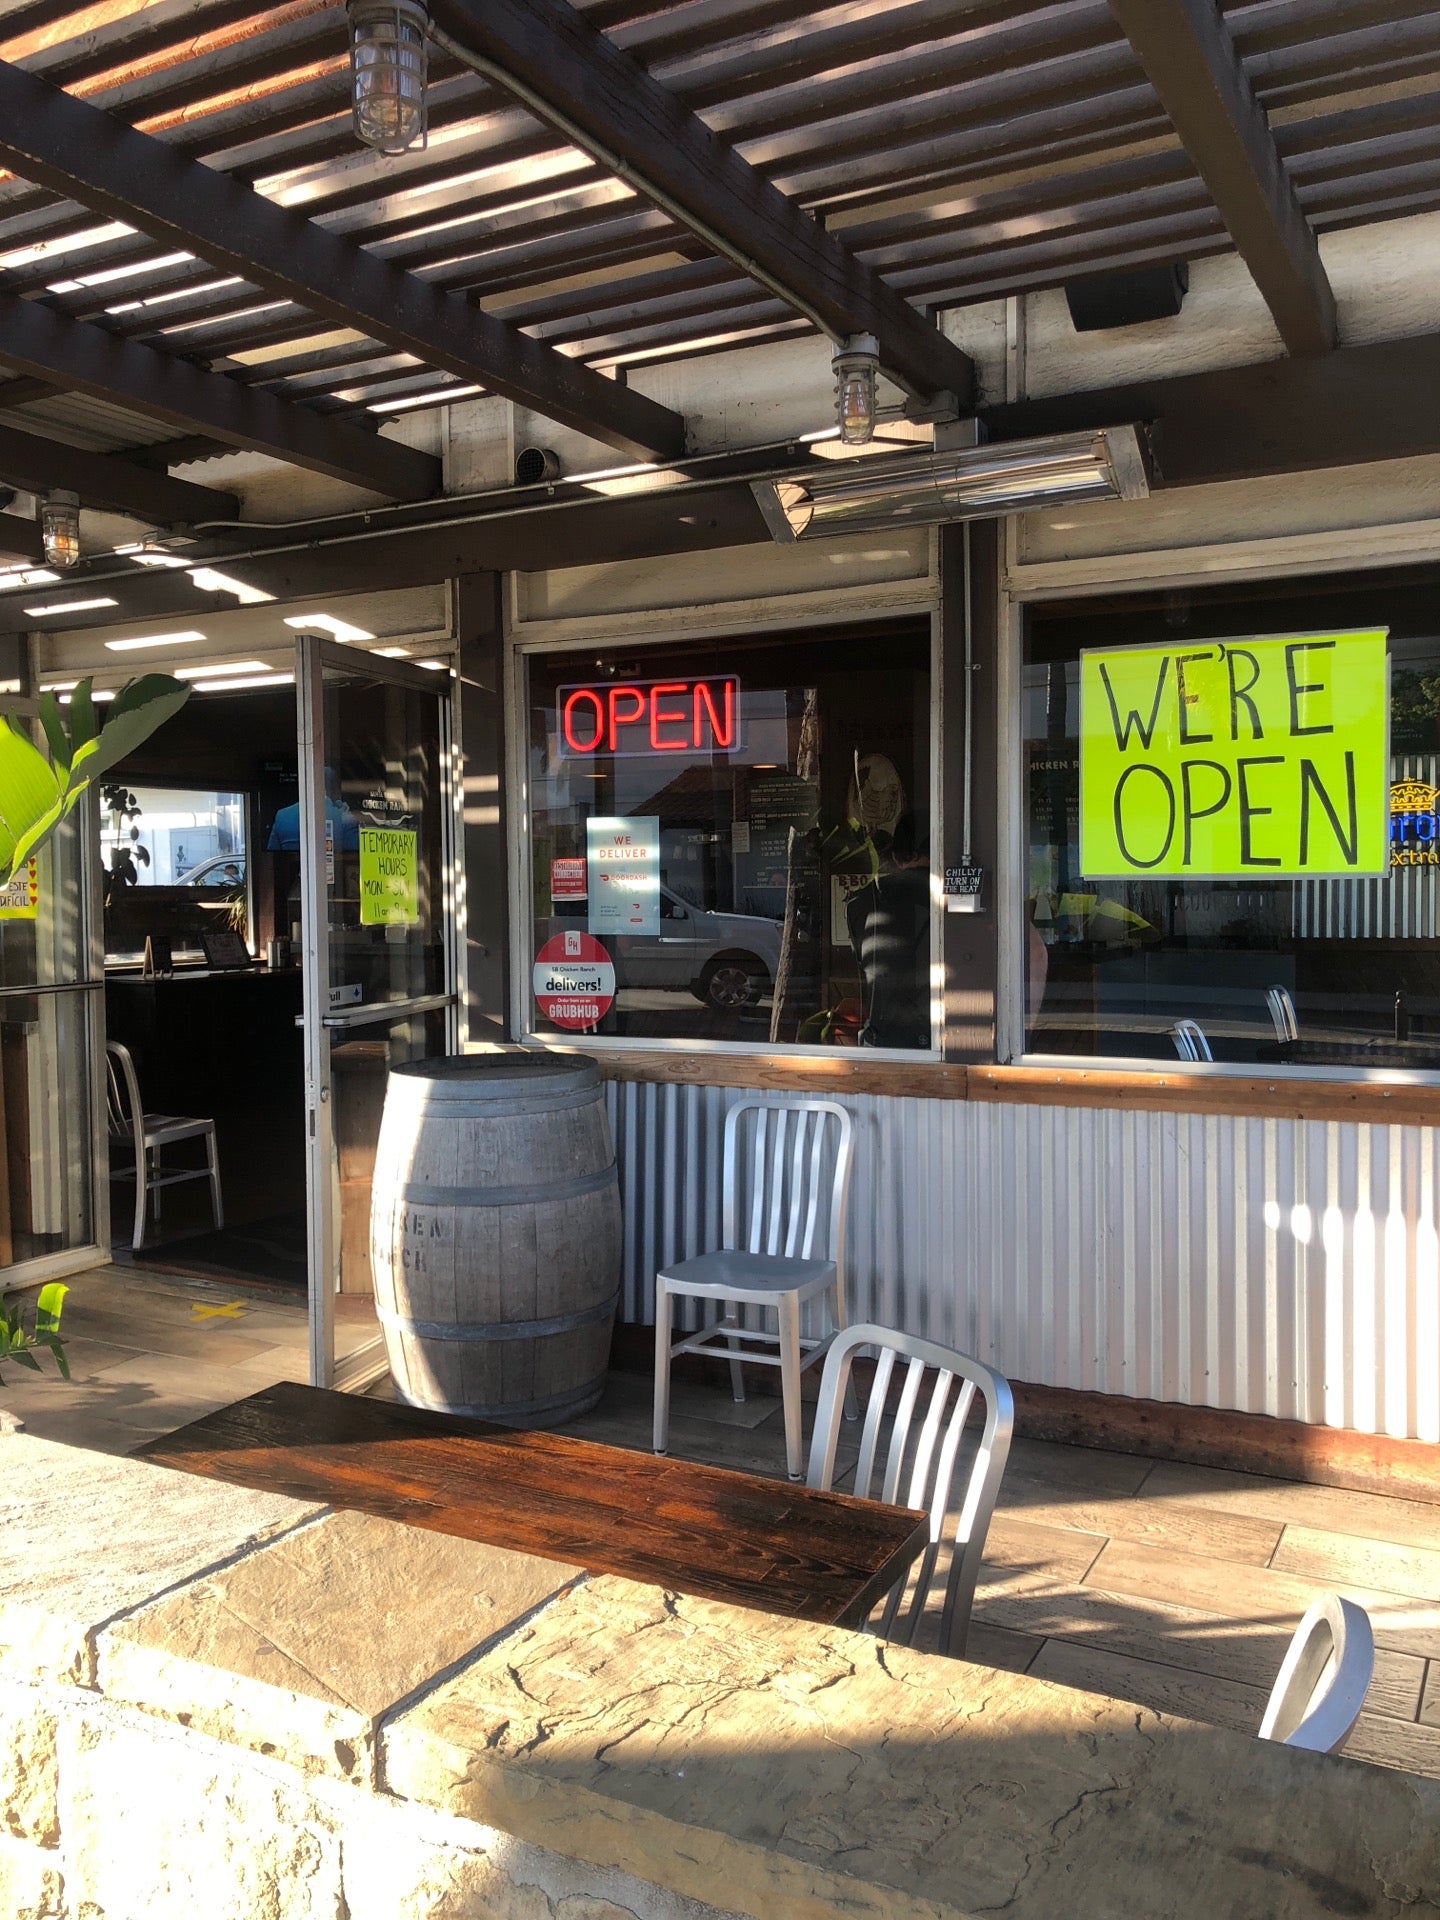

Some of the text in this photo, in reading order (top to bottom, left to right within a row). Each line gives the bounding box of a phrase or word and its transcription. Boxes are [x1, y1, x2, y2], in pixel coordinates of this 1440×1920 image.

[1099, 641, 1336, 752] WE'RE
[564, 682, 732, 753] OPEN
[1029, 760, 1068, 770] HICKEN
[1113, 751, 1358, 869] OPEN
[360, 831, 415, 857] TEMPORARY
[613, 836, 631, 845] WE
[599, 848, 647, 858] DELIVER
[1390, 850, 1439, 866] xtra
[378, 857, 408, 876] HOURS
[945, 867, 983, 877] CHILLY?
[9, 881, 28, 892] ESTE
[945, 876, 981, 886] TURN ON
[944, 885, 979, 893] THE HEAT
[545, 977, 602, 992] delivers!
[549, 1004, 599, 1018] GRUBHUB
